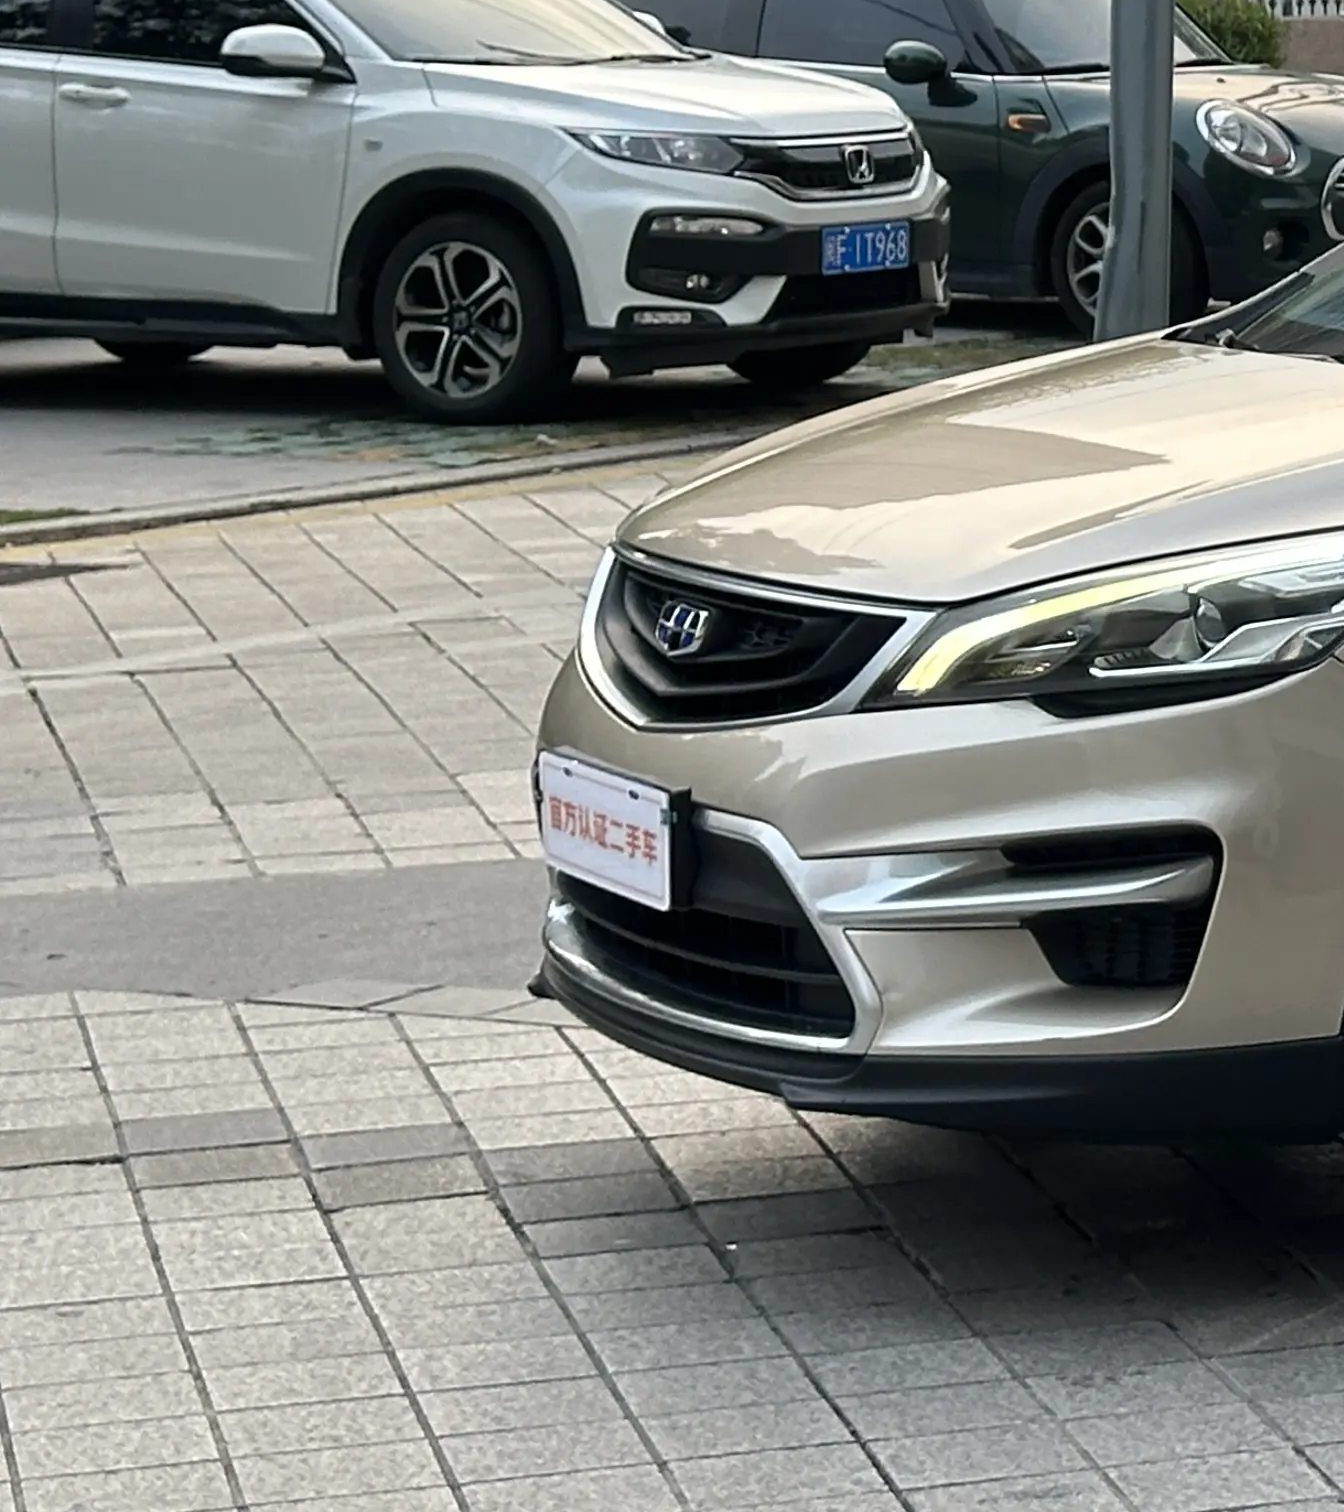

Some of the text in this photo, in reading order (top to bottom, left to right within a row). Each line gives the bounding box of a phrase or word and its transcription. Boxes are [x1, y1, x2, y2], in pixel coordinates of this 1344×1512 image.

[548, 795, 658, 866] 官方认证二手车
